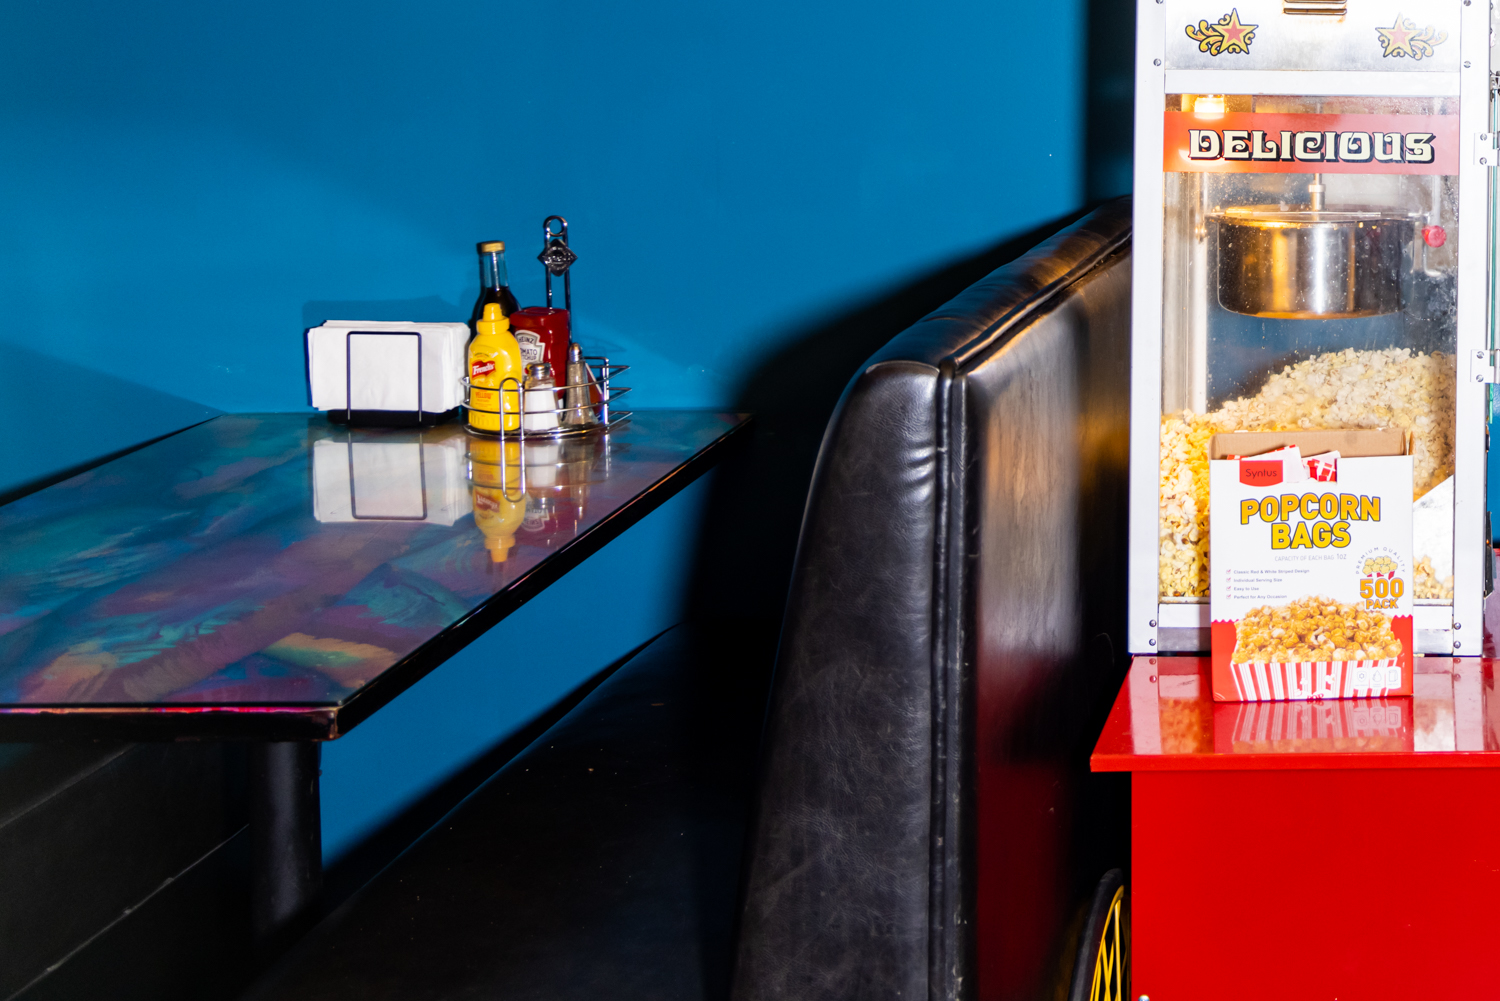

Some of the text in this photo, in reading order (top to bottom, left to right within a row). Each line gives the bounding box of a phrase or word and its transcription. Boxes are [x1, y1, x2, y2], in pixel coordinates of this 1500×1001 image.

[1187, 129, 1435, 164] DELICIOUS
[1245, 468, 1278, 480] Syntus
[1240, 492, 1381, 525] POPCORN
[1271, 520, 1351, 550] BAGS
[1355, 546, 1406, 575] PREMIUM QUALITY
[1359, 577, 1405, 599] 500
[1365, 599, 1399, 610] PACK
